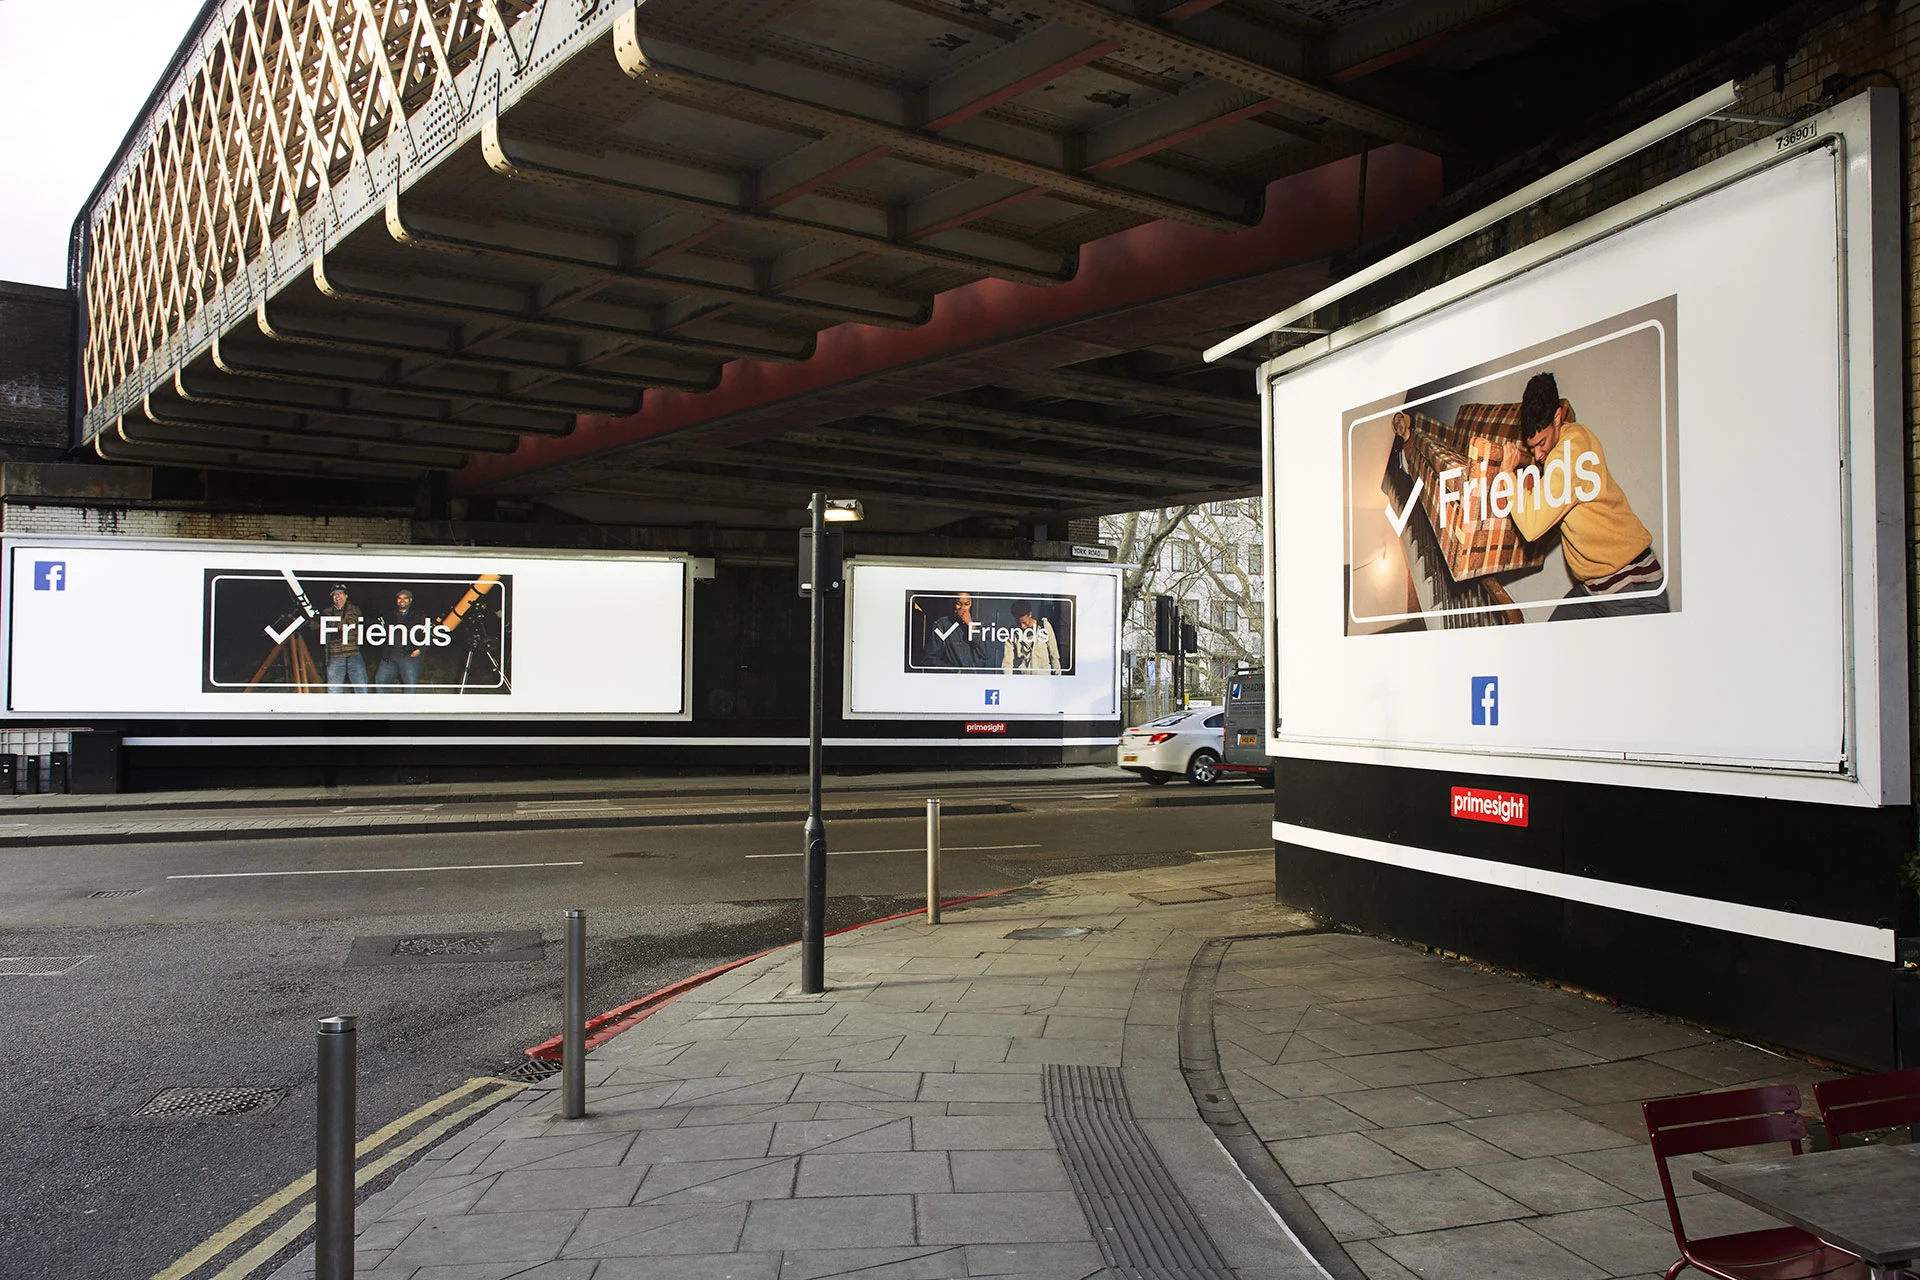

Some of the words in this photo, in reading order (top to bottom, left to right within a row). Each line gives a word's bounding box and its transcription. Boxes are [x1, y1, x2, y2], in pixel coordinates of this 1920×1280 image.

[1776, 123, 1814, 150] 736901
[1439, 440, 1601, 529] Friends
[1074, 547, 1087, 555] YORK
[320, 616, 452, 647] Friends
[968, 622, 1049, 643] Friends
[966, 723, 1004, 733] primesight
[1454, 791, 1524, 823] primesight
